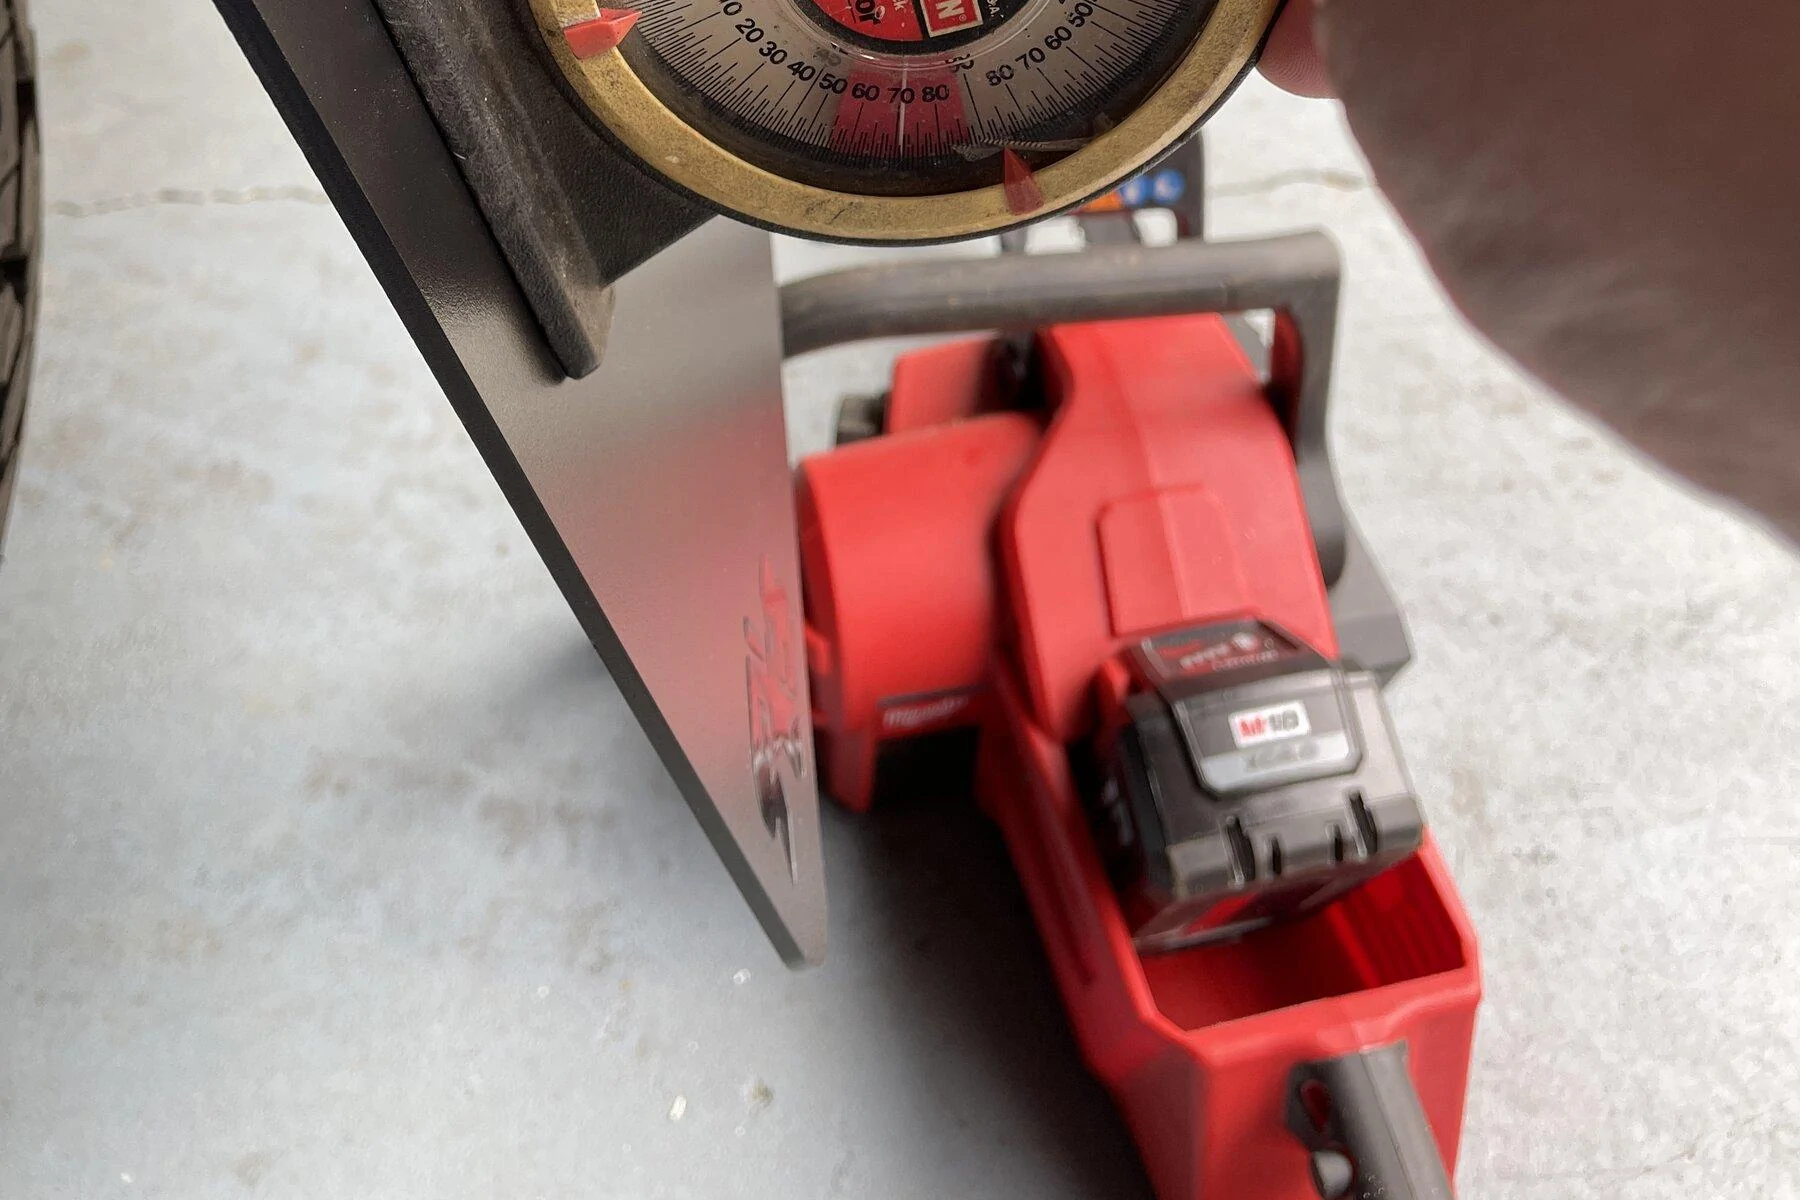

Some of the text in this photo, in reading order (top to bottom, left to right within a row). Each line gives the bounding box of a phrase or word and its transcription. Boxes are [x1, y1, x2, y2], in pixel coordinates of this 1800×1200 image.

[1068, 2, 1093, 28] 50
[735, 17, 765, 43] 20
[1044, 25, 1072, 50] 60
[758, 41, 788, 65] 30
[1015, 47, 1046, 71] 70
[787, 61, 816, 82] 40
[818, 72, 848, 95] 50
[985, 64, 1015, 87] 80
[851, 82, 950, 105] 60 70 80
